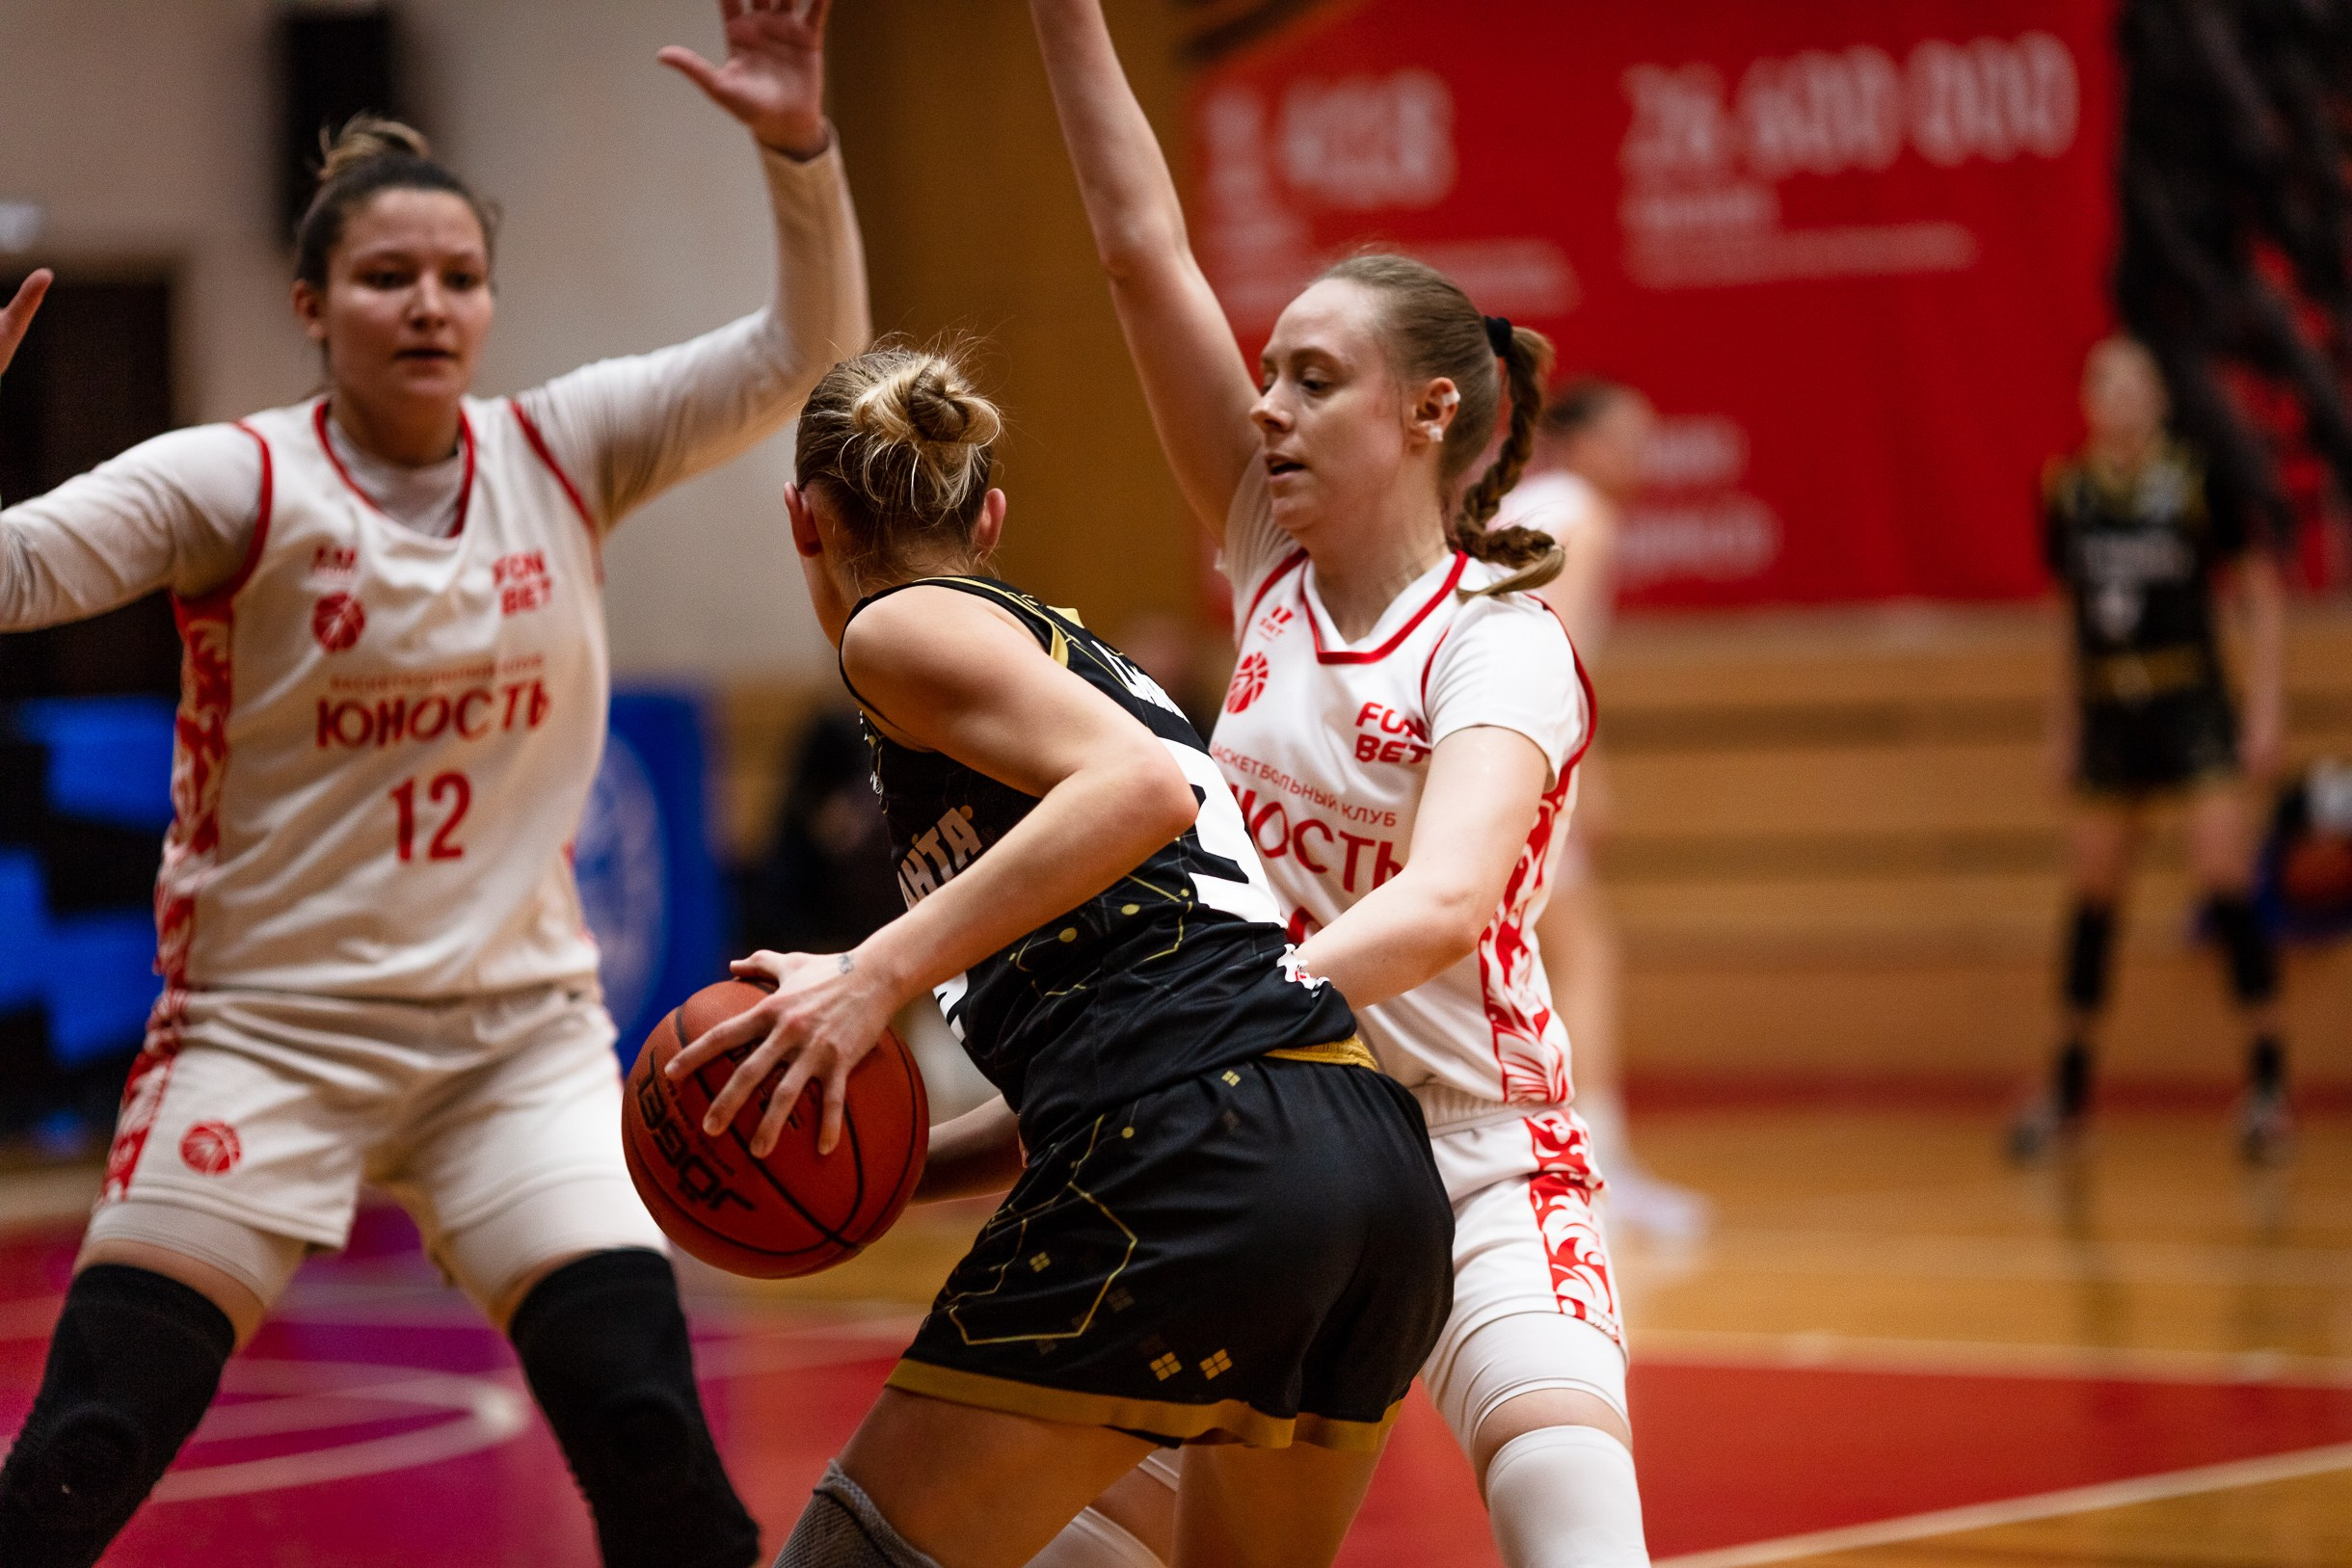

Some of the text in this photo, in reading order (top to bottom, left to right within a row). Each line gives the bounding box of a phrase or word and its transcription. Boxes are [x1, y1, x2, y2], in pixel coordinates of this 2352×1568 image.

[316, 678, 551, 750] ЮНОСТЬ
[1355, 733, 1432, 764] BET
[390, 770, 471, 864] 12
[1341, 803, 1397, 828] КЛУБ
